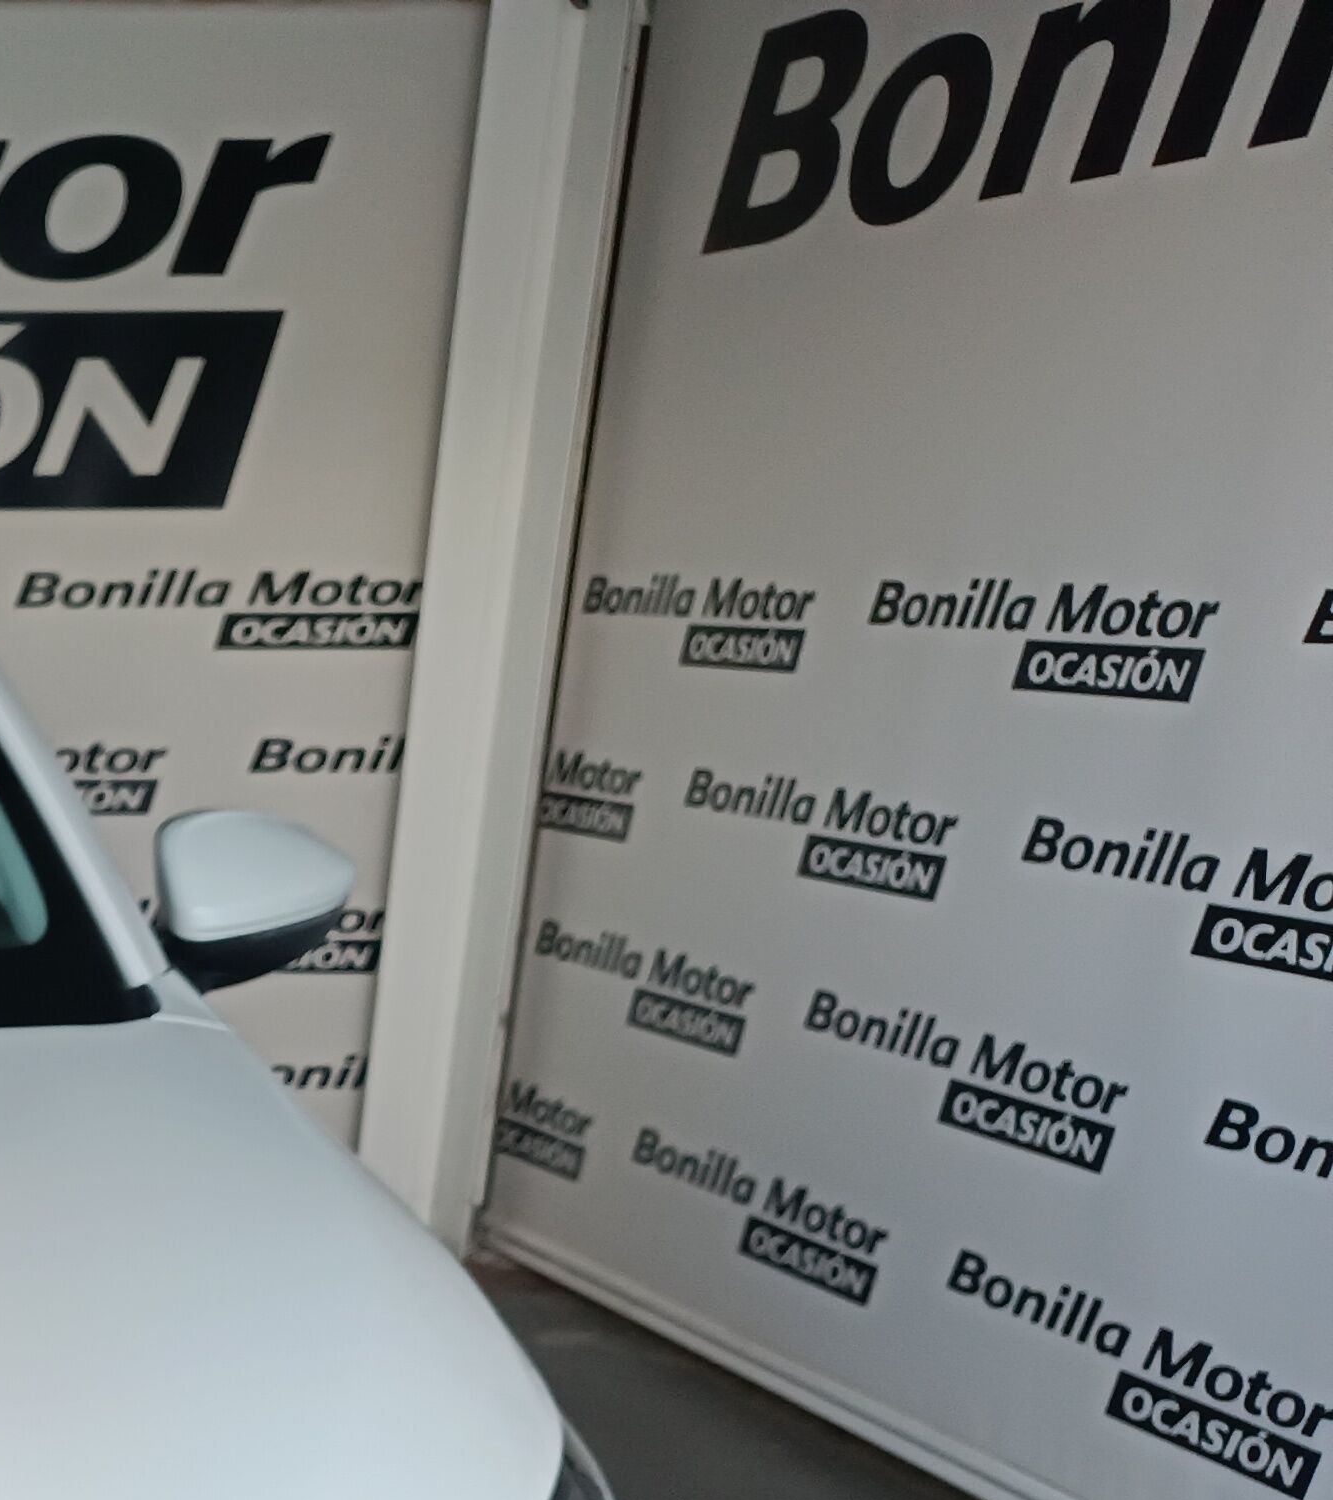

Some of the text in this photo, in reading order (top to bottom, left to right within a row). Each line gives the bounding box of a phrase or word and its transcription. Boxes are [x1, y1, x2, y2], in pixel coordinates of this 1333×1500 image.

[15, 568, 423, 608] Bonilla Motor
[582, 574, 815, 623] Bonilla Motor
[869, 579, 1220, 639] Bonilla Motor
[232, 613, 409, 645] OCASIÓN
[688, 625, 797, 668] OCASIÓN
[1027, 647, 1192, 695] OCASIÓN
[553, 750, 642, 795] Motor
[684, 768, 958, 847] Bonilla Motor
[809, 841, 937, 895] OCASIÓN
[1022, 816, 1221, 892] Bonilla
[536, 920, 755, 1008] Bonilla Motor
[804, 990, 1128, 1116] Bonilla Motor
[951, 1088, 1105, 1165] OCASIÓN
[632, 1128, 889, 1257] Bonilla Motor
[749, 1226, 871, 1298] OCASIÓN
[946, 1249, 1333, 1440] Bonilla Motor
[1121, 1384, 1306, 1490] OCASIÓN
